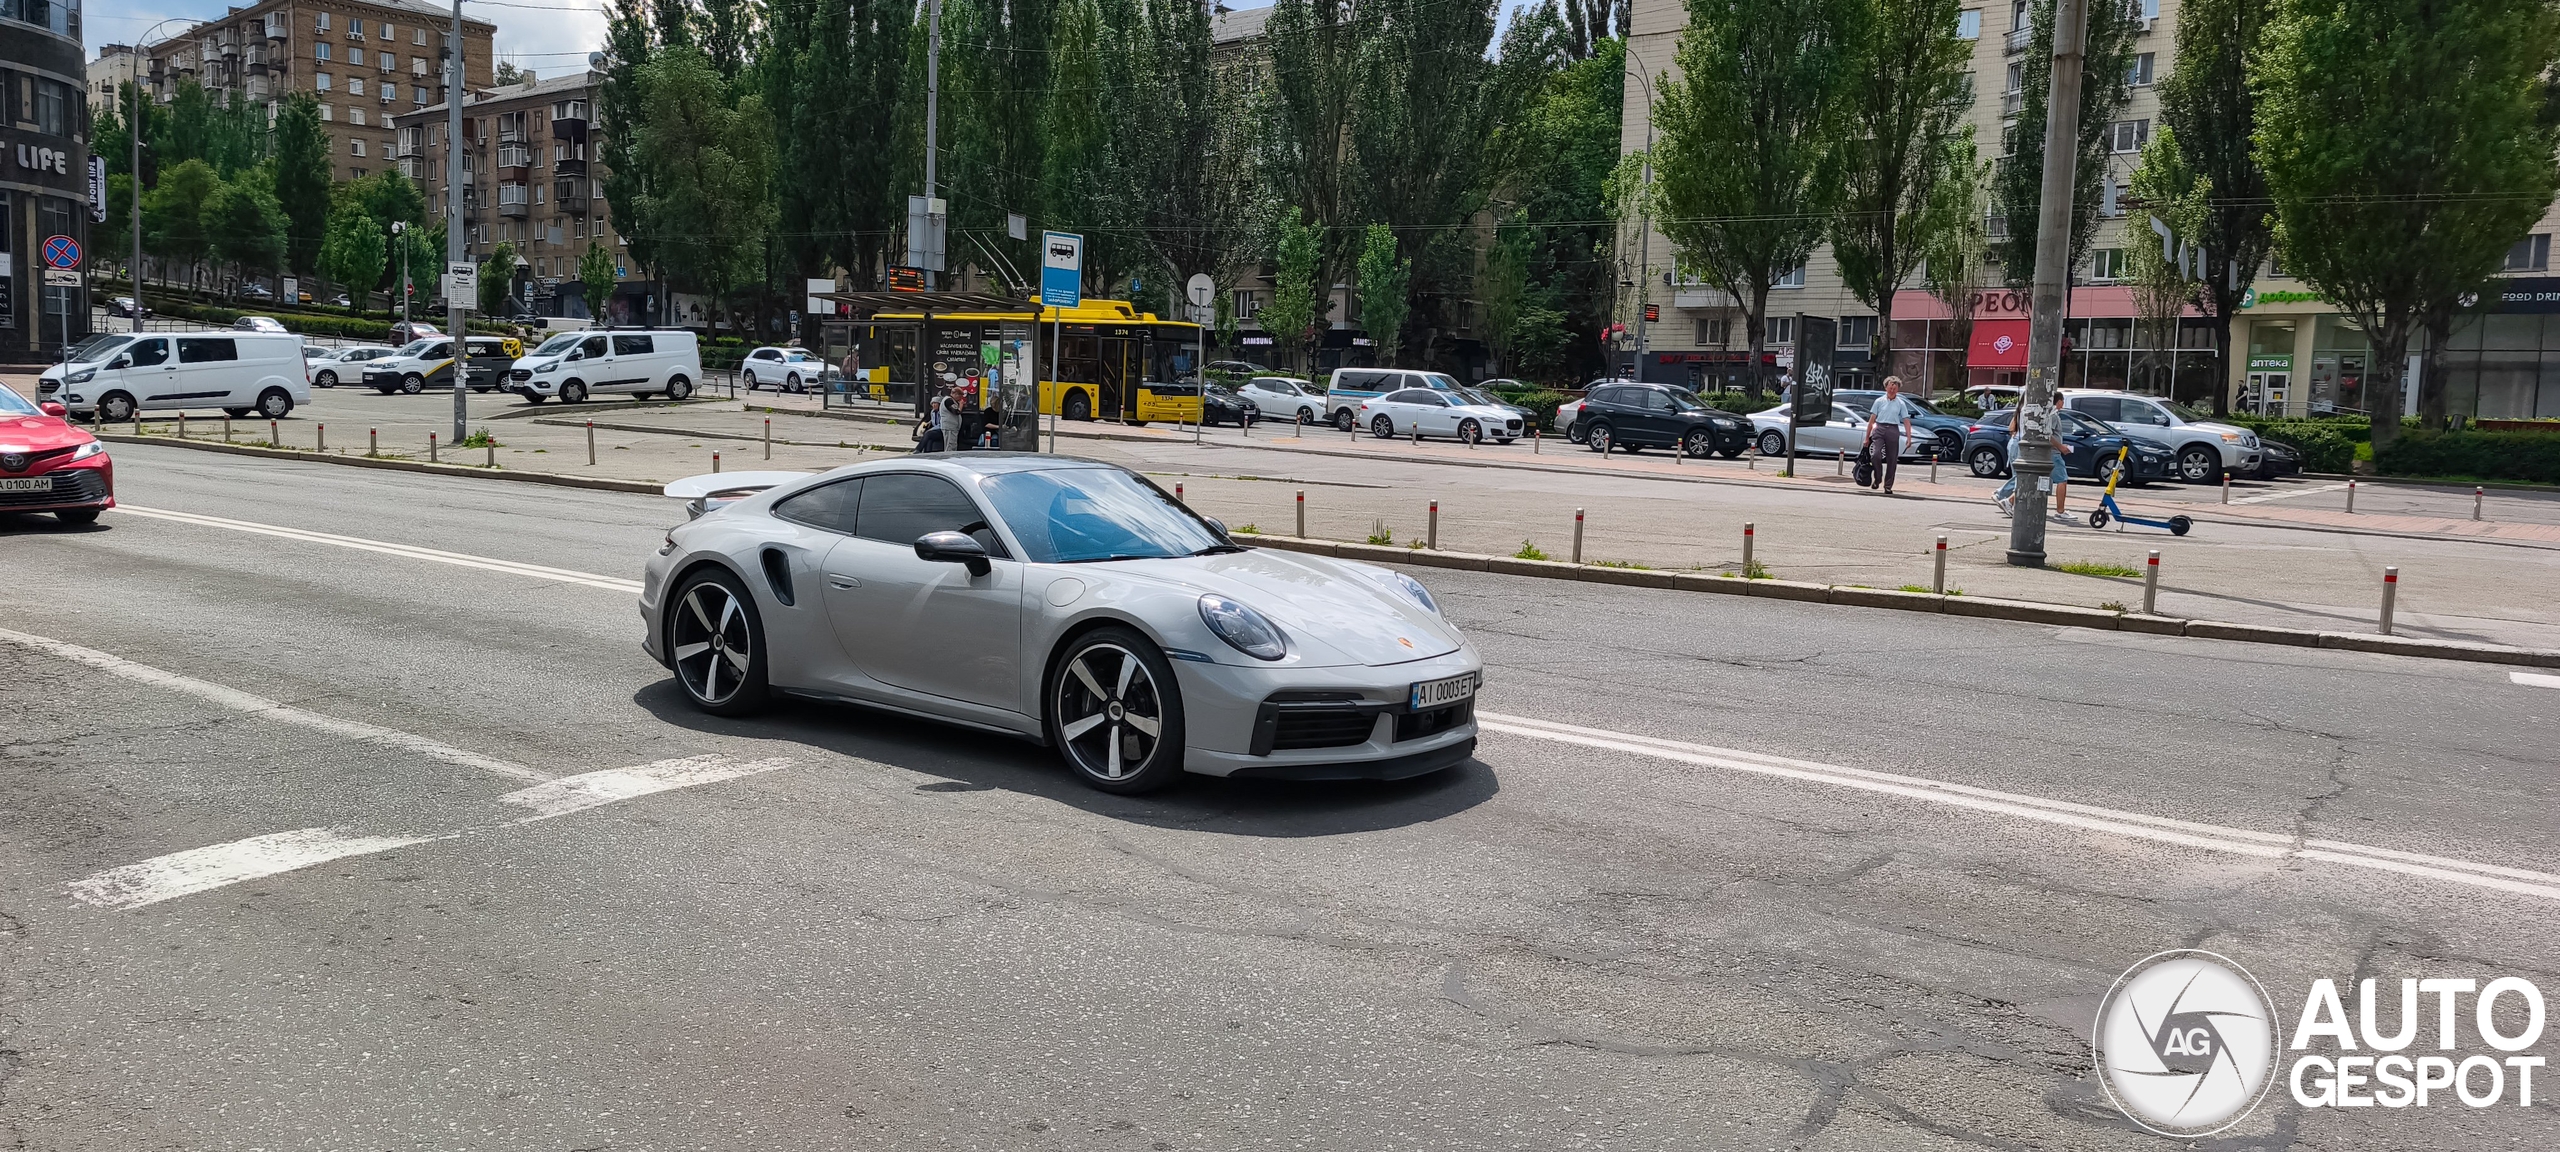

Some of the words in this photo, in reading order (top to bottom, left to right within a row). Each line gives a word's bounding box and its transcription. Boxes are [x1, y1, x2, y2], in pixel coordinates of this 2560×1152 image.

[18, 144, 66, 174] LIFE
[89, 180, 97, 204] SPORT
[2258, 290, 2321, 304] доброг
[2502, 293, 2532, 302] FOOD
[1243, 337, 1273, 345] SAMSUNG
[2250, 359, 2289, 368] аптека
[6, 479, 31, 490] 0100
[33, 479, 49, 489] AM
[1418, 685, 1433, 705] AI
[1436, 680, 1460, 701] 0003
[1460, 676, 1474, 696] ET
